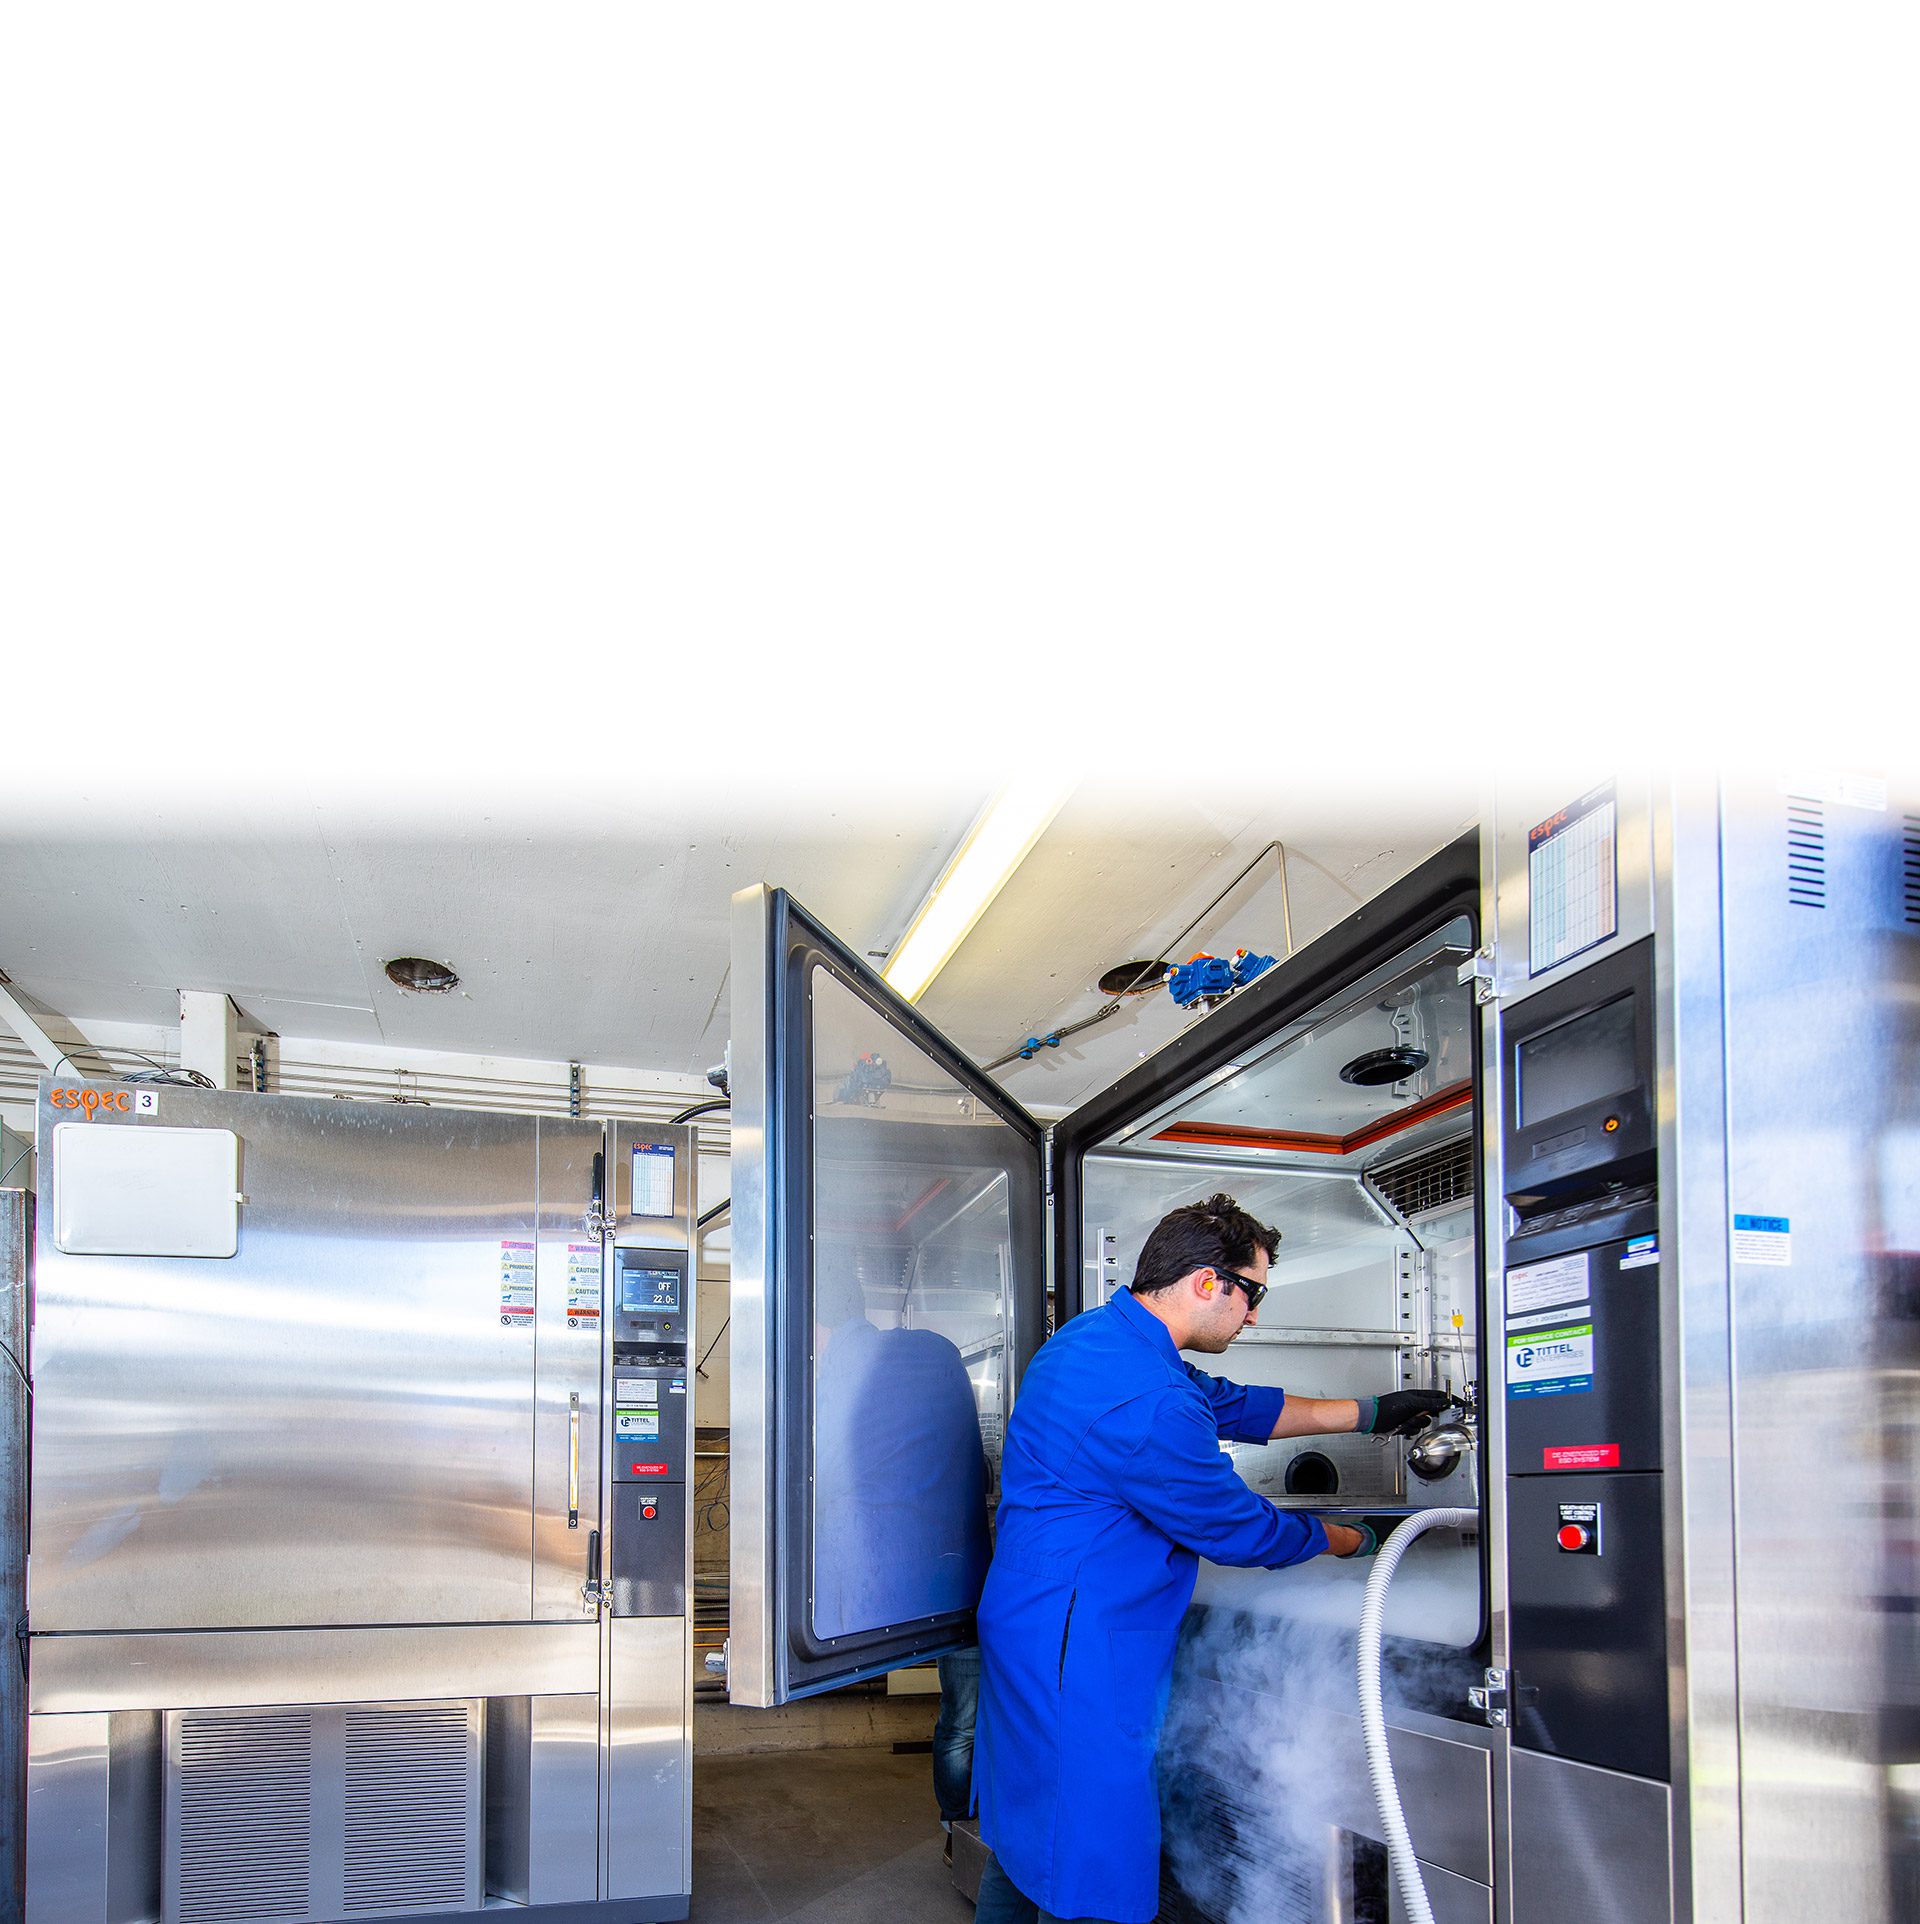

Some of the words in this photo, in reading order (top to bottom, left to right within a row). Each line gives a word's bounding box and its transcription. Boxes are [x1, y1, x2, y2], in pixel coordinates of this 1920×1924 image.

[141, 1095, 152, 1107] 3
[1750, 1217, 1782, 1231] NOTICE
[658, 1282, 671, 1291] OFF
[574, 1309, 600, 1317] WARNING
[1536, 1344, 1573, 1356] TITTEL
